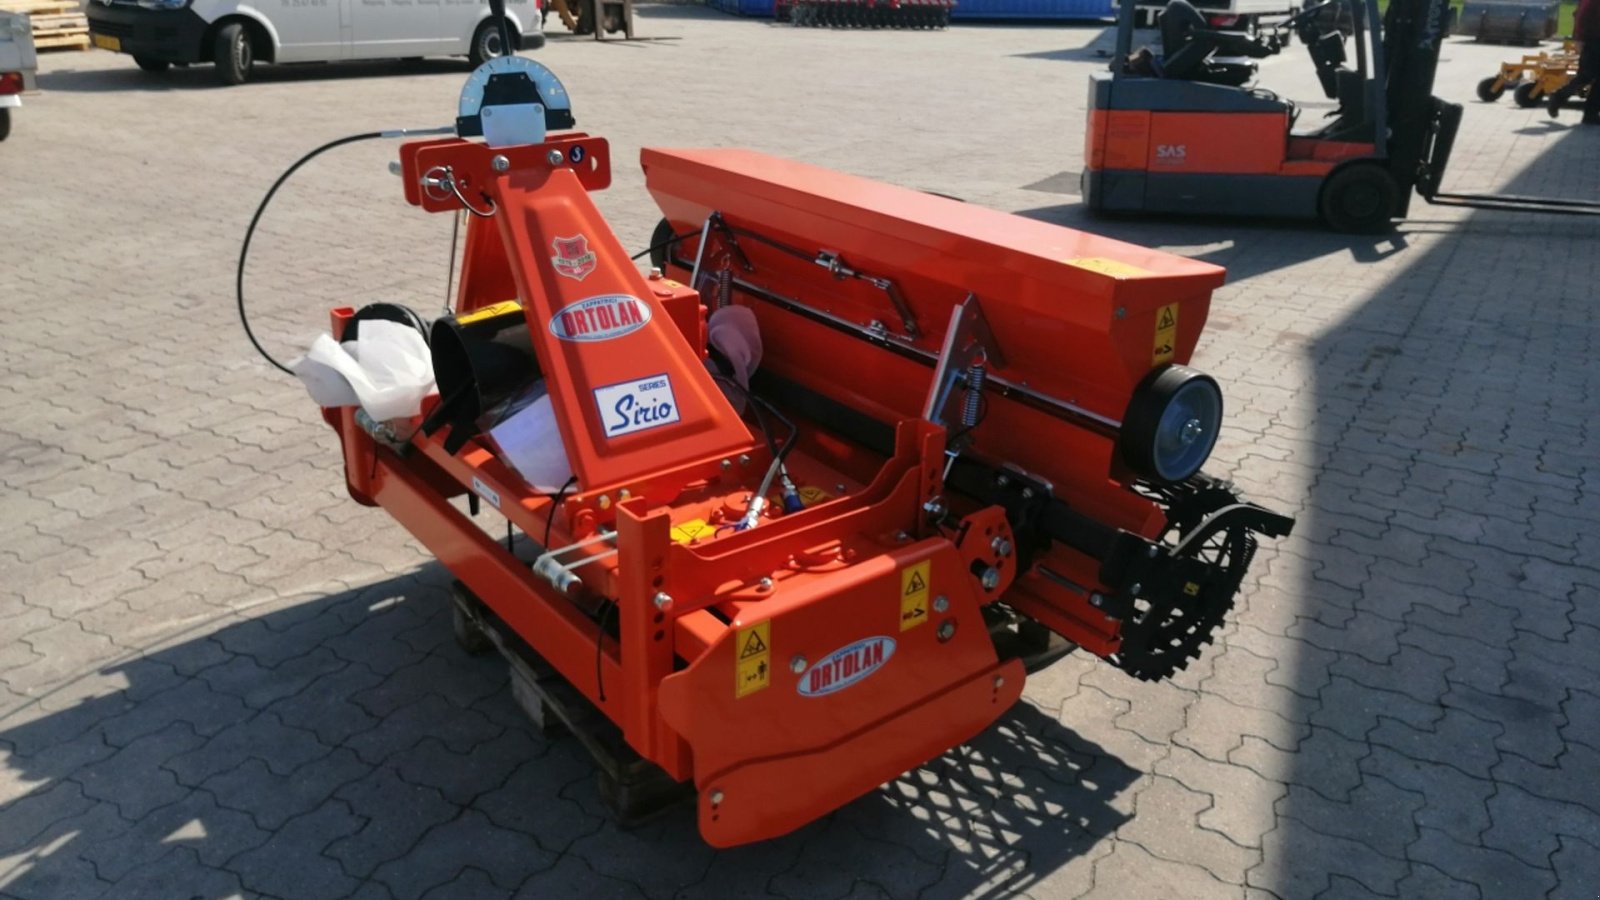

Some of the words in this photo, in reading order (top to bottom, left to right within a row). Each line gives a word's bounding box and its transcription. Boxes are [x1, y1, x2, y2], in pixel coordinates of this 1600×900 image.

[1156, 144, 1187, 158] SAS
[561, 300, 643, 337] ORTOLAN
[638, 379, 667, 392] SERIES
[610, 393, 672, 431] Sirio
[810, 639, 884, 692] ORTOLAN
